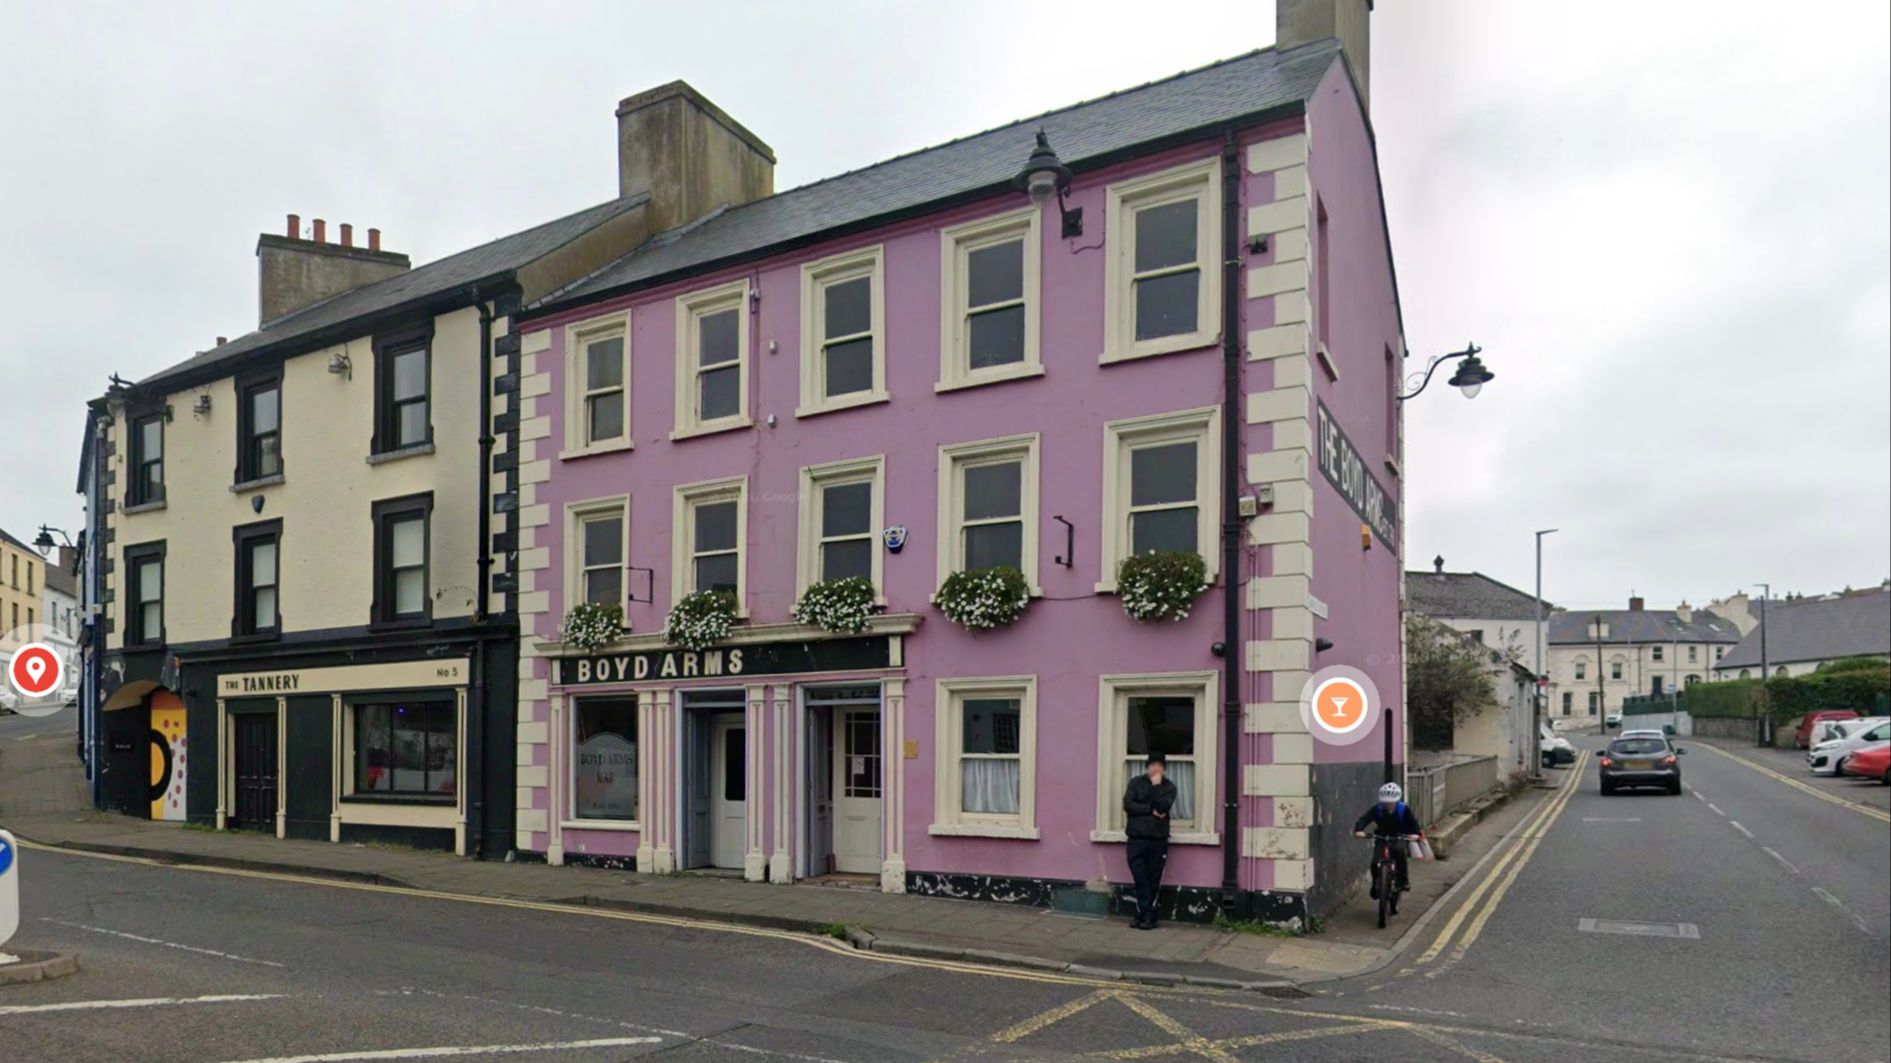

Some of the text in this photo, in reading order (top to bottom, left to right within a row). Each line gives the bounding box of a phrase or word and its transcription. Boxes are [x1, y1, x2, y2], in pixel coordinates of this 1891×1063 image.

[1318, 405, 1338, 481] THE
[1341, 438, 1363, 510] BOYD
[436, 667, 458, 677] No 5
[577, 649, 743, 682] BOYD ARMS
[225, 674, 300, 692] THE TANNERY
